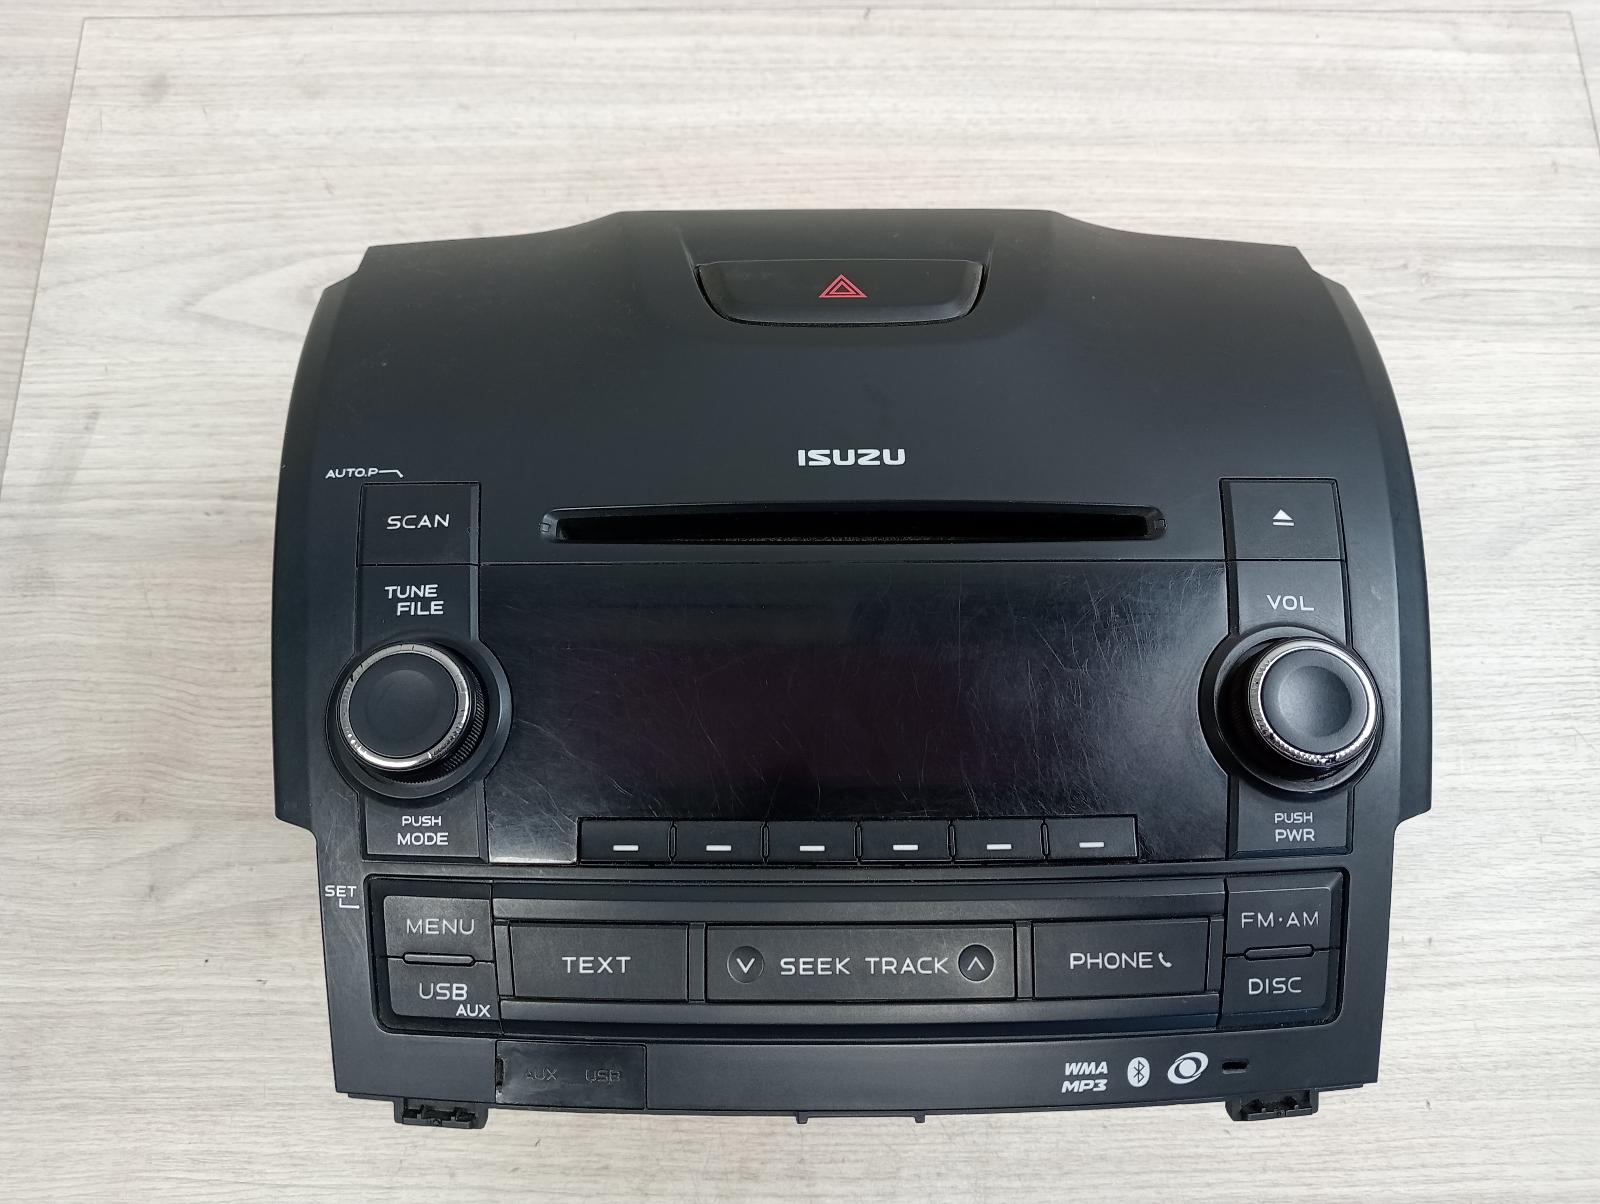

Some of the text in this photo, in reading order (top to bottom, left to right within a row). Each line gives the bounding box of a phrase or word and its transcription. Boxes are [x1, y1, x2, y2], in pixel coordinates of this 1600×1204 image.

[797, 448, 906, 467] ISUZU
[325, 467, 379, 479] AUTO.P
[386, 513, 450, 530] SCAN
[384, 584, 438, 599] TUNE
[396, 600, 444, 616] FILE
[1266, 594, 1315, 611] VOL
[401, 815, 442, 827] PUSH
[1274, 811, 1313, 824] PUSH
[397, 832, 449, 846] MODE
[1275, 828, 1315, 842] PWR
[324, 884, 357, 898] SET
[406, 918, 475, 935] MENU
[561, 956, 631, 974] TEXT
[780, 956, 949, 975] SEEK TRACK
[1069, 951, 1153, 970] PHONE
[419, 982, 468, 1001] USB
[1248, 976, 1302, 995] DISC
[455, 1003, 491, 1018] AUX
[526, 1068, 558, 1081] AUX
[585, 1069, 621, 1083] USB
[1064, 1061, 1108, 1076] WMA
[1061, 1078, 1108, 1093] MP3
